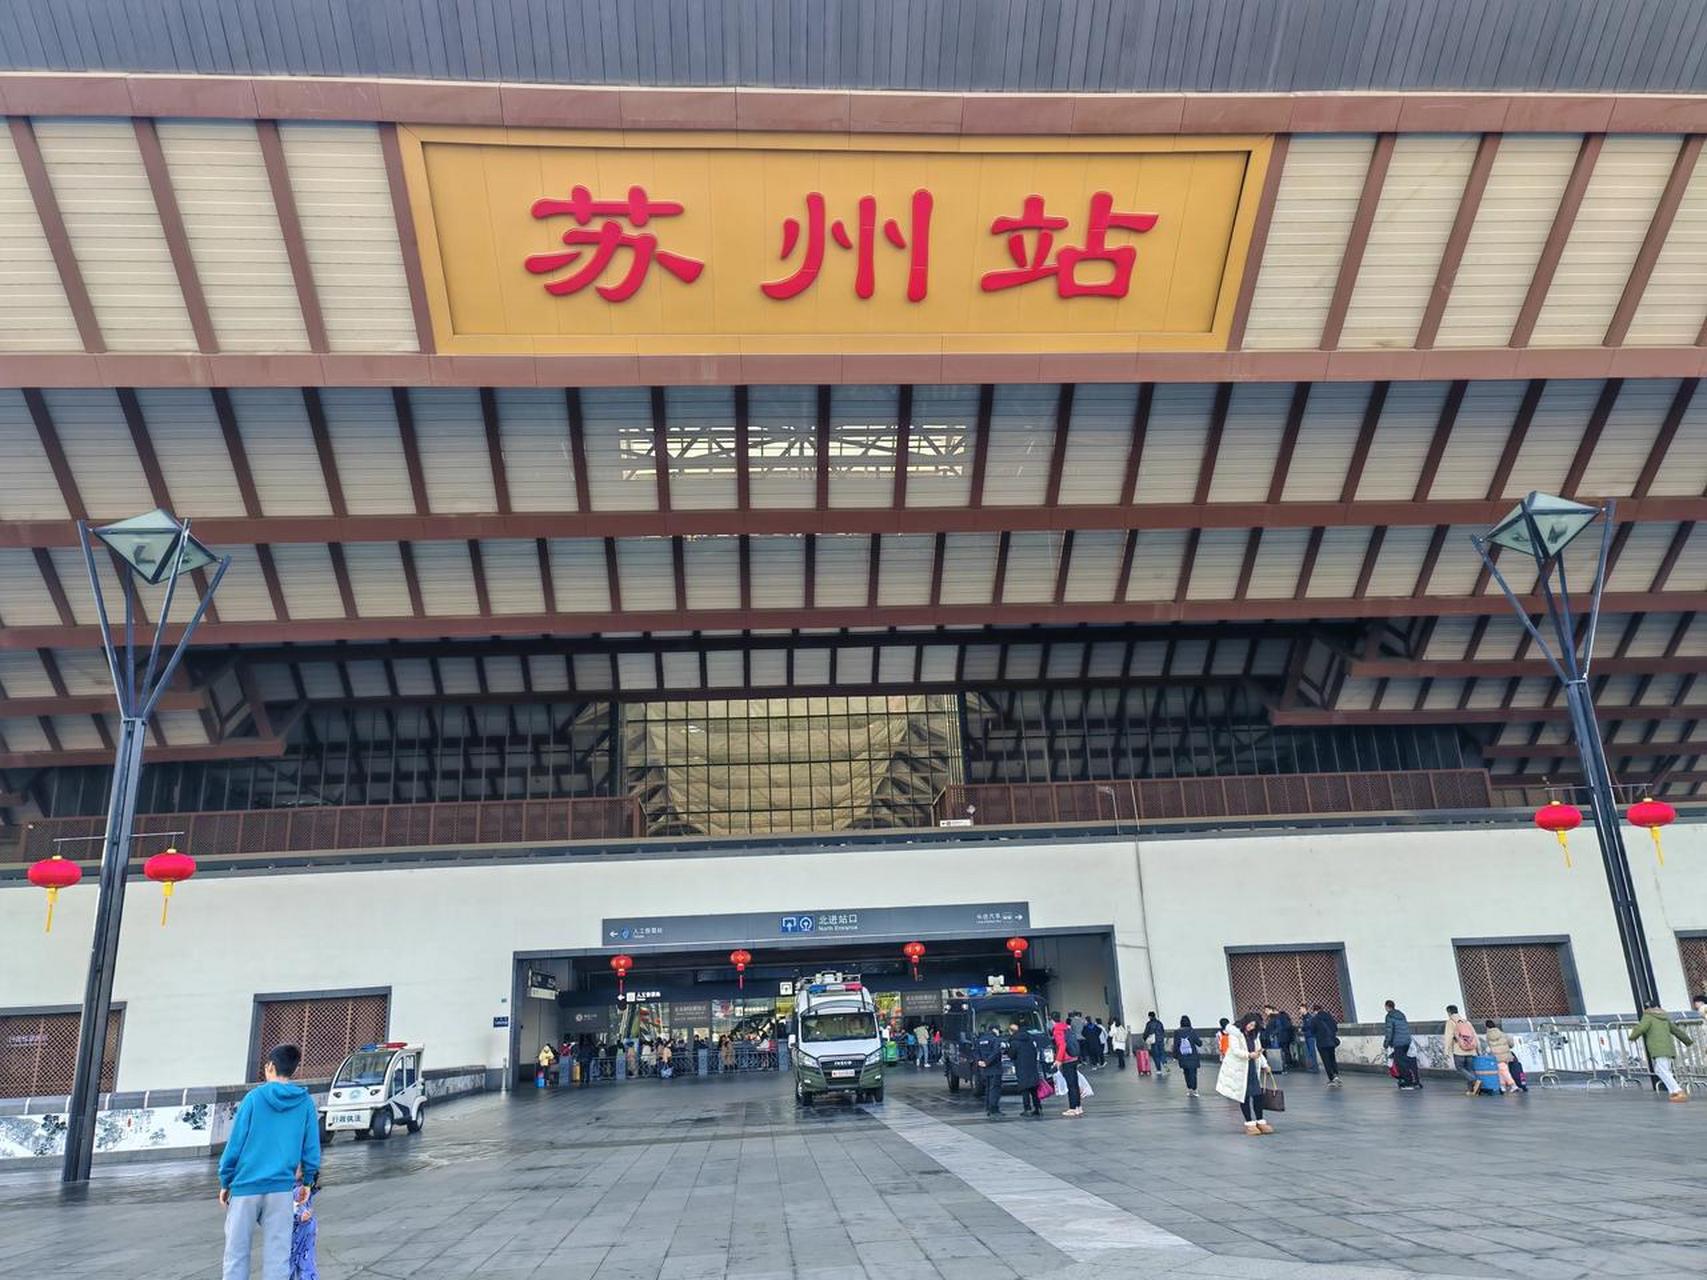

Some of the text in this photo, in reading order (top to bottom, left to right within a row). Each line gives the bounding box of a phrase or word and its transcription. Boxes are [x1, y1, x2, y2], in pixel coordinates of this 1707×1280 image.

[525, 185, 1159, 301] 苏州站
[819, 914, 858, 926] 北进站口
[332, 1114, 361, 1123] 行政执法
